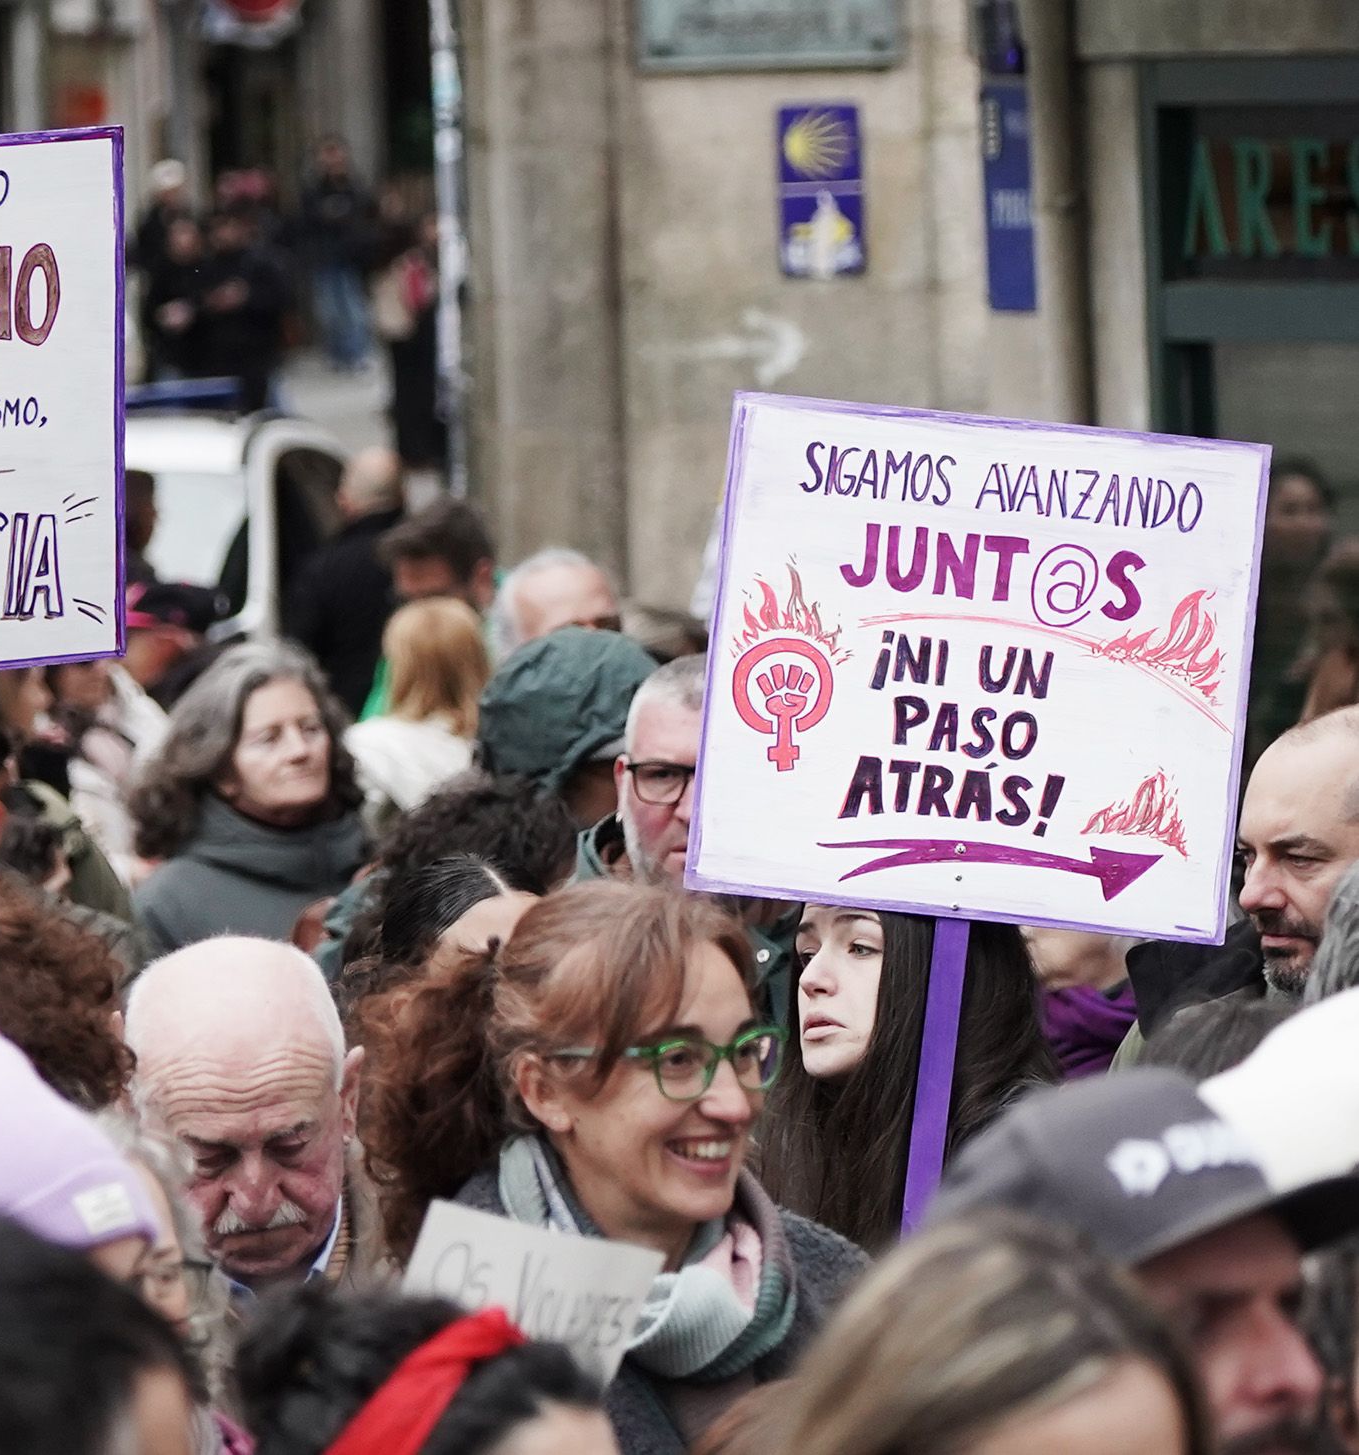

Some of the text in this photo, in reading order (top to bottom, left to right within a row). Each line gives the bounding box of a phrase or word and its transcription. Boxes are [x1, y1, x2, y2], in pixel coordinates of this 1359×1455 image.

[799, 441, 1204, 533] SIGAMOS AVANZANDO
[839, 522, 1147, 628] JUNT@S
[869, 629, 1055, 700] ¡NI UN
[892, 695, 1038, 761] PASO
[837, 755, 1066, 838] ATRÁS!
